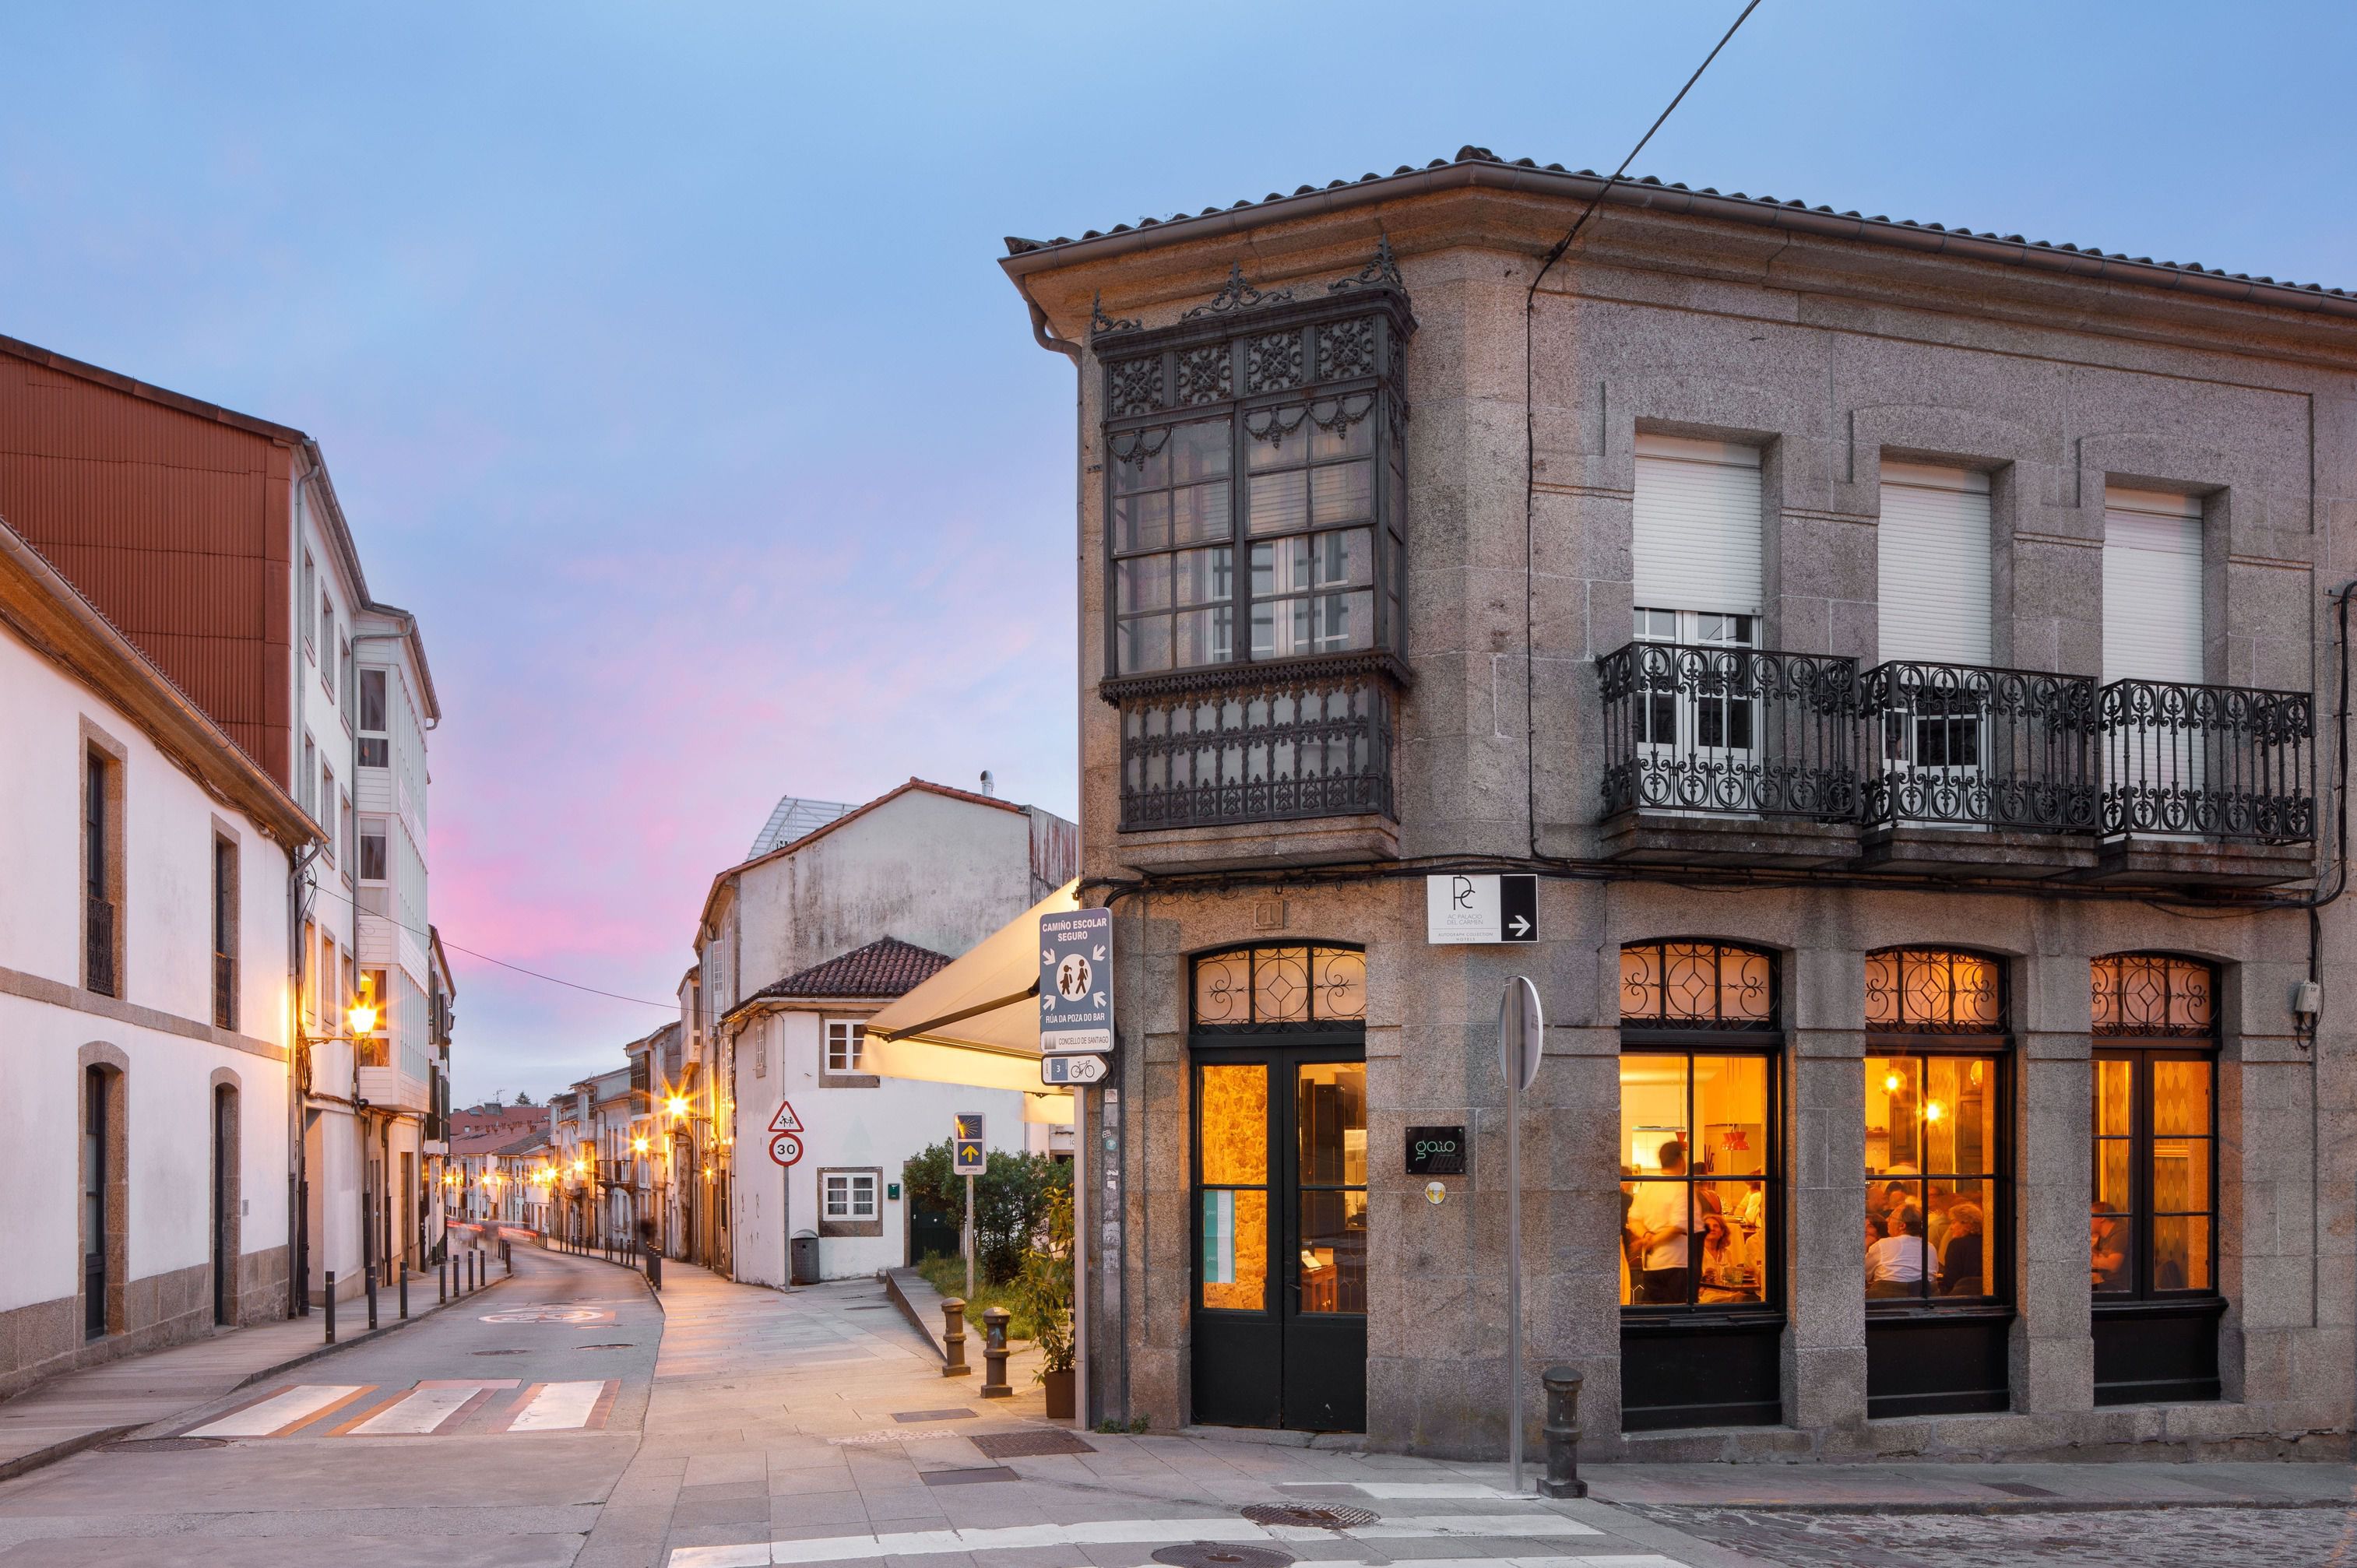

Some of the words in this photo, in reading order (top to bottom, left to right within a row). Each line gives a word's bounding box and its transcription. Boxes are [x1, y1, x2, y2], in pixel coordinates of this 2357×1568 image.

[1043, 920, 1071, 932] CAMIÑO
[1073, 918, 1106, 929] ESCOLAR
[1057, 931, 1088, 941] SEGURO
[1046, 1014, 1057, 1023] RÚA
[1058, 1014, 1067, 1023] DA
[1067, 1014, 1083, 1023] POZA
[1083, 1013, 1092, 1021] DO
[1092, 1013, 1105, 1021] BAR
[1081, 1036, 1087, 1045] DE
[1087, 1035, 1109, 1045] SANTIAGO
[1056, 1064, 1061, 1073] 3
[777, 1144, 796, 1155] 30
[1416, 1140, 1455, 1162] gaio
